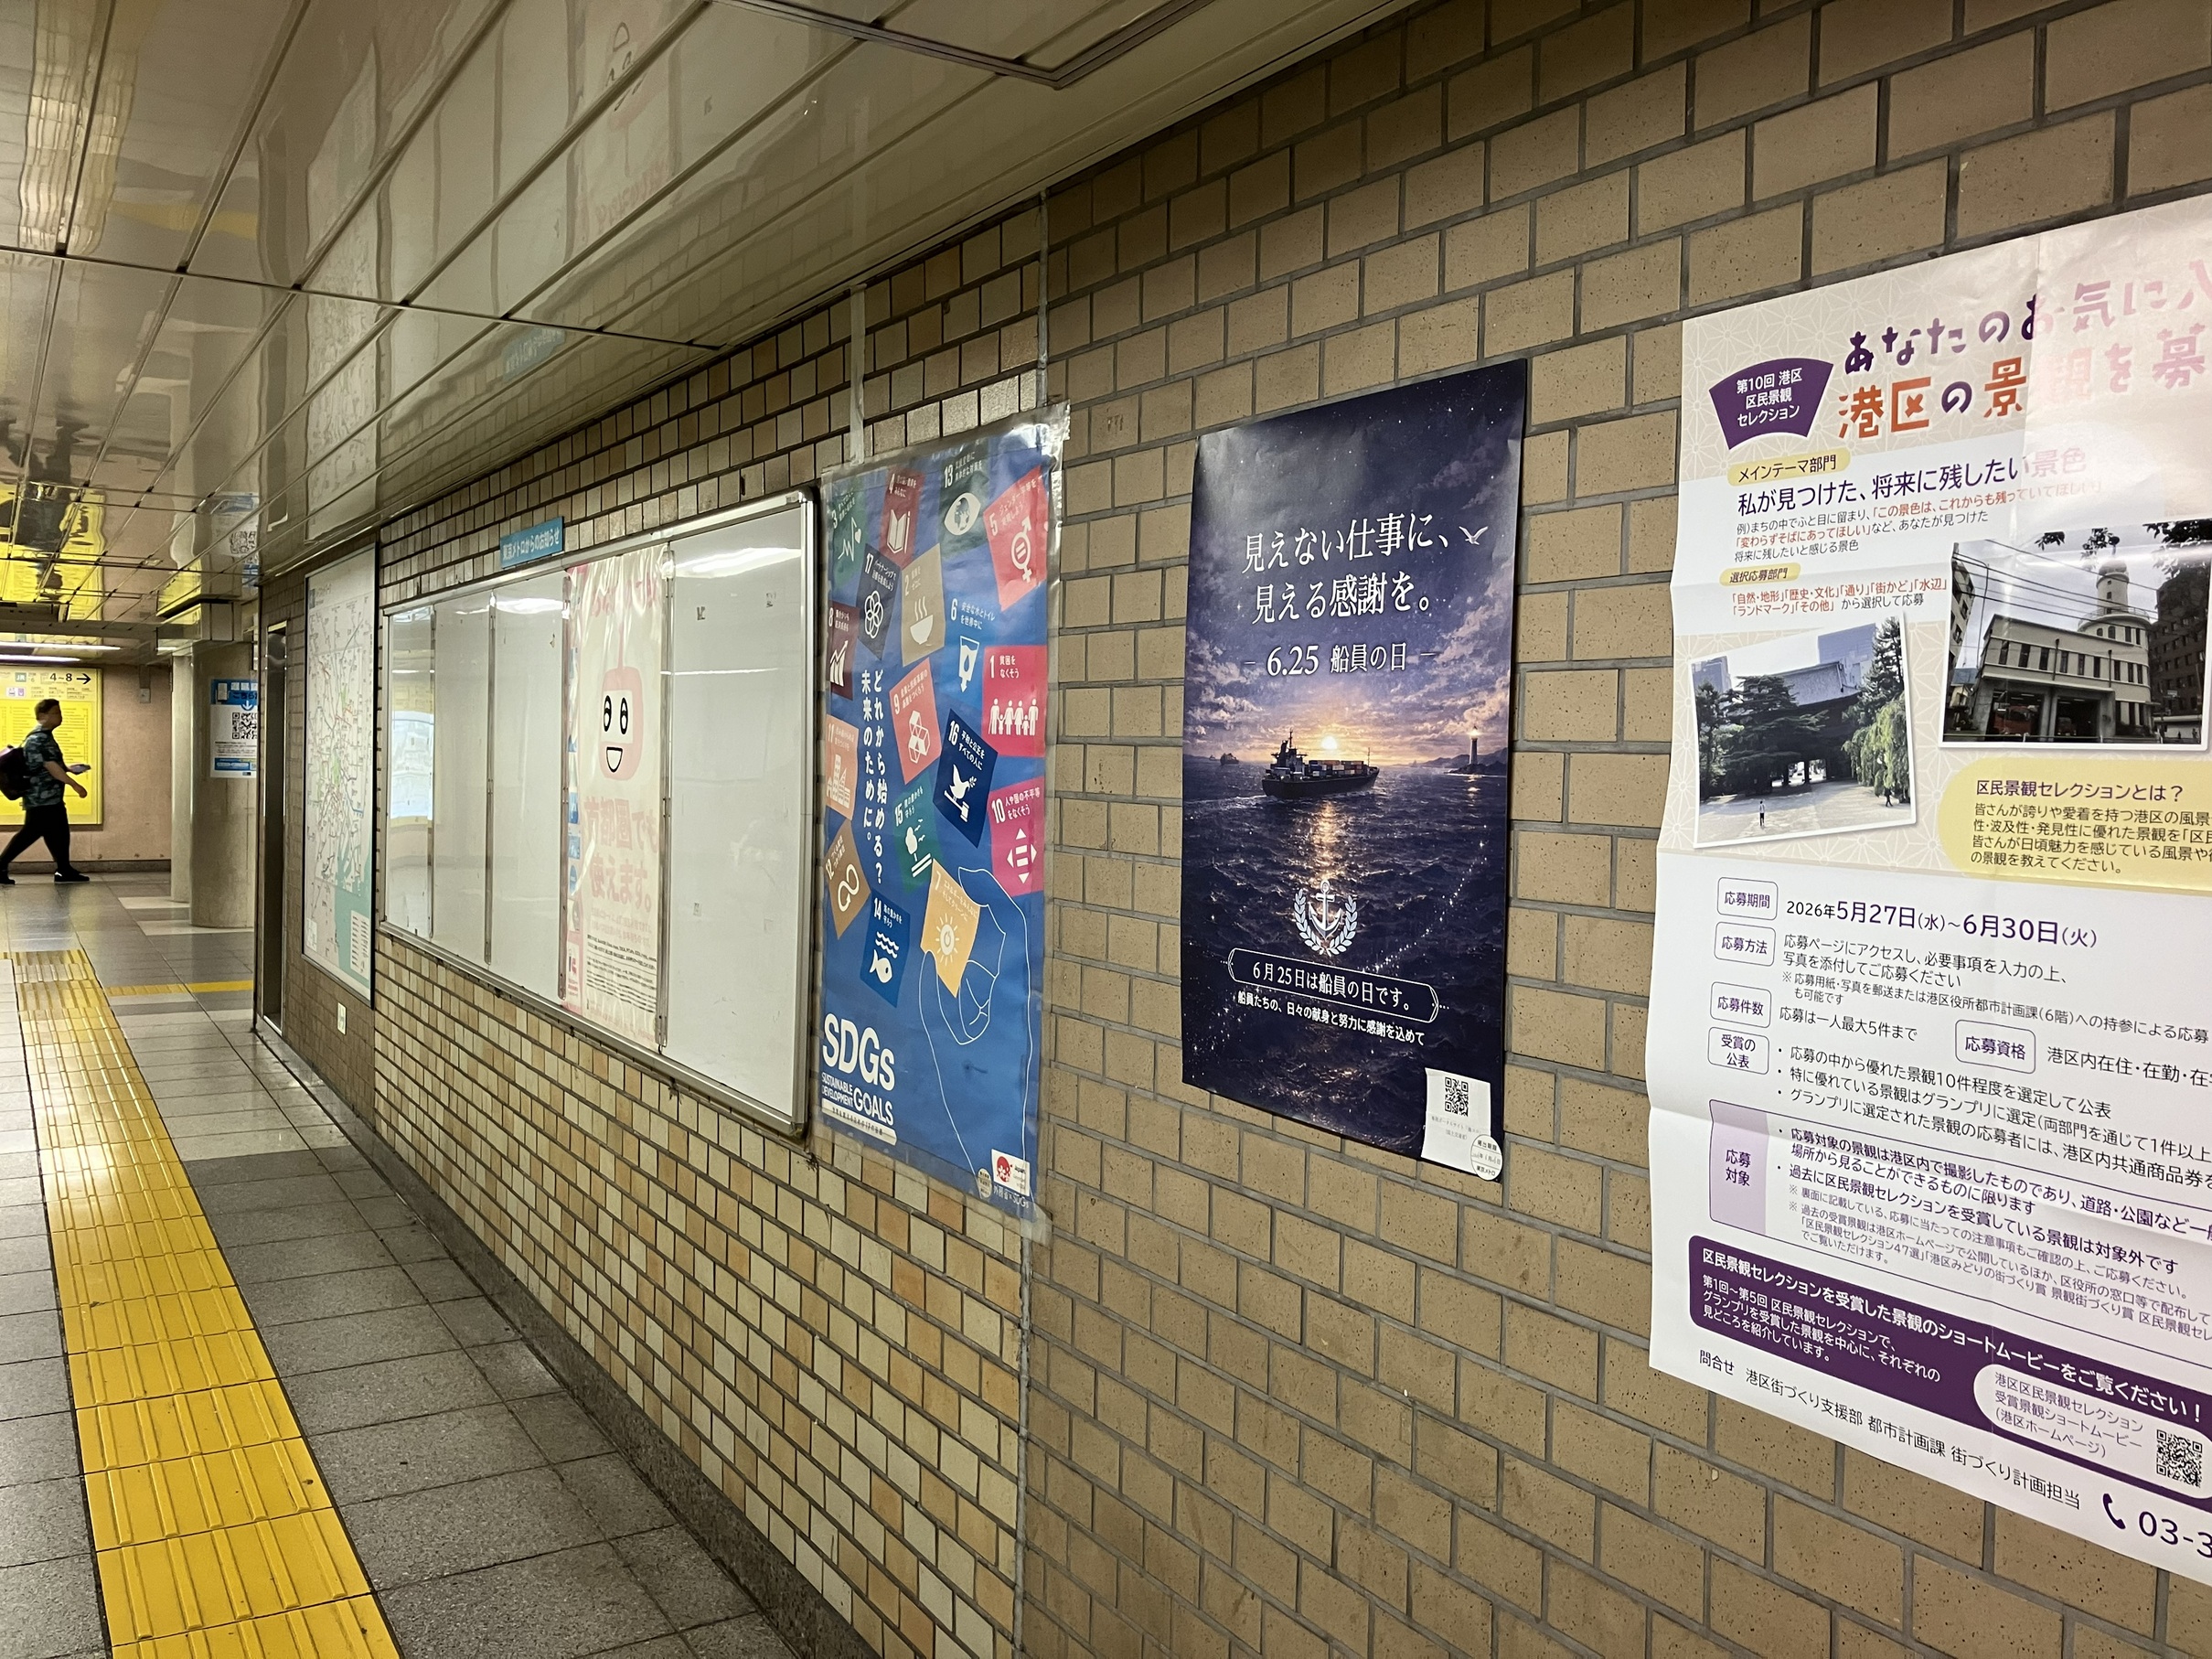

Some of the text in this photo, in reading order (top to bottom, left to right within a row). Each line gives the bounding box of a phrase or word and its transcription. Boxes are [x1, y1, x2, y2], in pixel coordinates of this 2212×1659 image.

[1736, 368, 1802, 394] 第10回 港区
[1746, 387, 1792, 410] 区民景観
[1737, 404, 1800, 427] セレクション
[944, 465, 953, 487] 13
[1738, 455, 1836, 483] メインテーマ部門
[1738, 447, 2086, 516] 私が見つけた、将来に残したい景色
[989, 513, 998, 536] 5
[1736, 510, 1988, 548] 「変わらずそばにあってほしい」など、あなたが見つけた
[1242, 512, 1449, 573] 見えない仕事に、
[1735, 540, 1858, 562] 将来に残したいと感じる景色
[865, 552, 874, 574] 17
[1729, 568, 1788, 583] 選択応募部門
[904, 574, 910, 596] 2
[951, 598, 958, 621] 6
[1252, 571, 1429, 625] 見える感謝を。
[1841, 594, 1924, 610] から選択して応募
[828, 607, 834, 627] 8
[960, 615, 982, 630] を世界中に
[961, 602, 995, 621] 安全な水とトイレ
[989, 655, 995, 679] 1
[999, 655, 1016, 666] 貧困を
[1266, 642, 1407, 677] 6.25 船員の日
[999, 668, 1020, 679] なくそう
[893, 693, 900, 715] 9
[948, 720, 960, 746] 16
[961, 730, 986, 760] 平和と公正を
[861, 669, 875, 841] 未来のために。
[958, 743, 983, 771] すべての人に
[873, 669, 888, 884] どれから始める？
[1005, 787, 1041, 807] 人や国の不平等
[1976, 780, 2183, 802] 区民景観セレクションとは？
[894, 802, 903, 827] 15
[991, 798, 1006, 824] 10
[1008, 804, 1031, 819] をなくそう
[1975, 803, 2212, 827] 皆さんが誇りや愛着を持つ港区の風景
[825, 857, 835, 880] 12
[1971, 851, 2122, 874] の景観を教えてください。
[874, 897, 882, 920] 14
[1724, 891, 1770, 910] 応募期間
[1721, 936, 1768, 956] 応募方法
[1782, 952, 1961, 989] 写真を添付してご応募ください
[1784, 934, 2066, 984] 応募ページにアクセスし、必要事項を入力の上、
[1716, 995, 1764, 1016] 応募件数
[1793, 987, 1843, 1006] も可能です
[1237, 991, 1426, 1045] 船員たちの、日々の献身と努力に感謝を込めて
[1779, 1006, 1918, 1042] 応募は一人最大5件まで
[822, 1012, 895, 1091] SDGs
[1721, 1034, 1756, 1053] 受賞の
[1964, 1035, 2026, 1061] 応募資格
[1726, 1052, 1749, 1069] 公表
[2047, 1046, 2212, 1087] 港区内在住・在勤・在
[821, 1072, 853, 1096] SUSTAINABLE
[1790, 1045, 2111, 1119] 応募の中から優れた景観10件程度を選定して公表
[821, 1085, 853, 1107] DEVELOPMENT
[853, 1087, 893, 1126] GOALS
[1726, 1149, 1751, 1168] 応募
[1726, 1167, 1751, 1187] 対象
[1791, 1145, 2036, 1215] 場所から見ることができるものに限ります
[1791, 1128, 2212, 1241] 応募対象の景観は港区内で撮影したものであり、道路・公園など一
[1789, 1163, 2178, 1274] 過去に区民景観セレクションを受賞している景観は対象外です
[1801, 1232, 1888, 1264] でご覧いただけます。
[2051, 1287, 2133, 1321] 景観街づくり賞
[1704, 1247, 2201, 1422] 区民景観セレクションを受賞した景観のショートムービーをご覧ください！
[1704, 1308, 1830, 1363] 見どころを紹介しています。
[1771, 1298, 1896, 1350] 区民景観セレクションで、
[1704, 1290, 1940, 1384] グランプリを受賞した景観を中心に、それぞれの
[1995, 1372, 2143, 1432] 港区区民景観セレクション
[1700, 1350, 1734, 1375] 問合せ
[1746, 1369, 1864, 1426] 港区街づくり支援部
[1868, 1415, 1946, 1459] 都市計画課
[1951, 1447, 2080, 1511] 街づくり計画担当
[1995, 1391, 2142, 1448] 受賞景観ショートムービー
[1995, 1407, 2106, 1458] (港区ホームページ)
